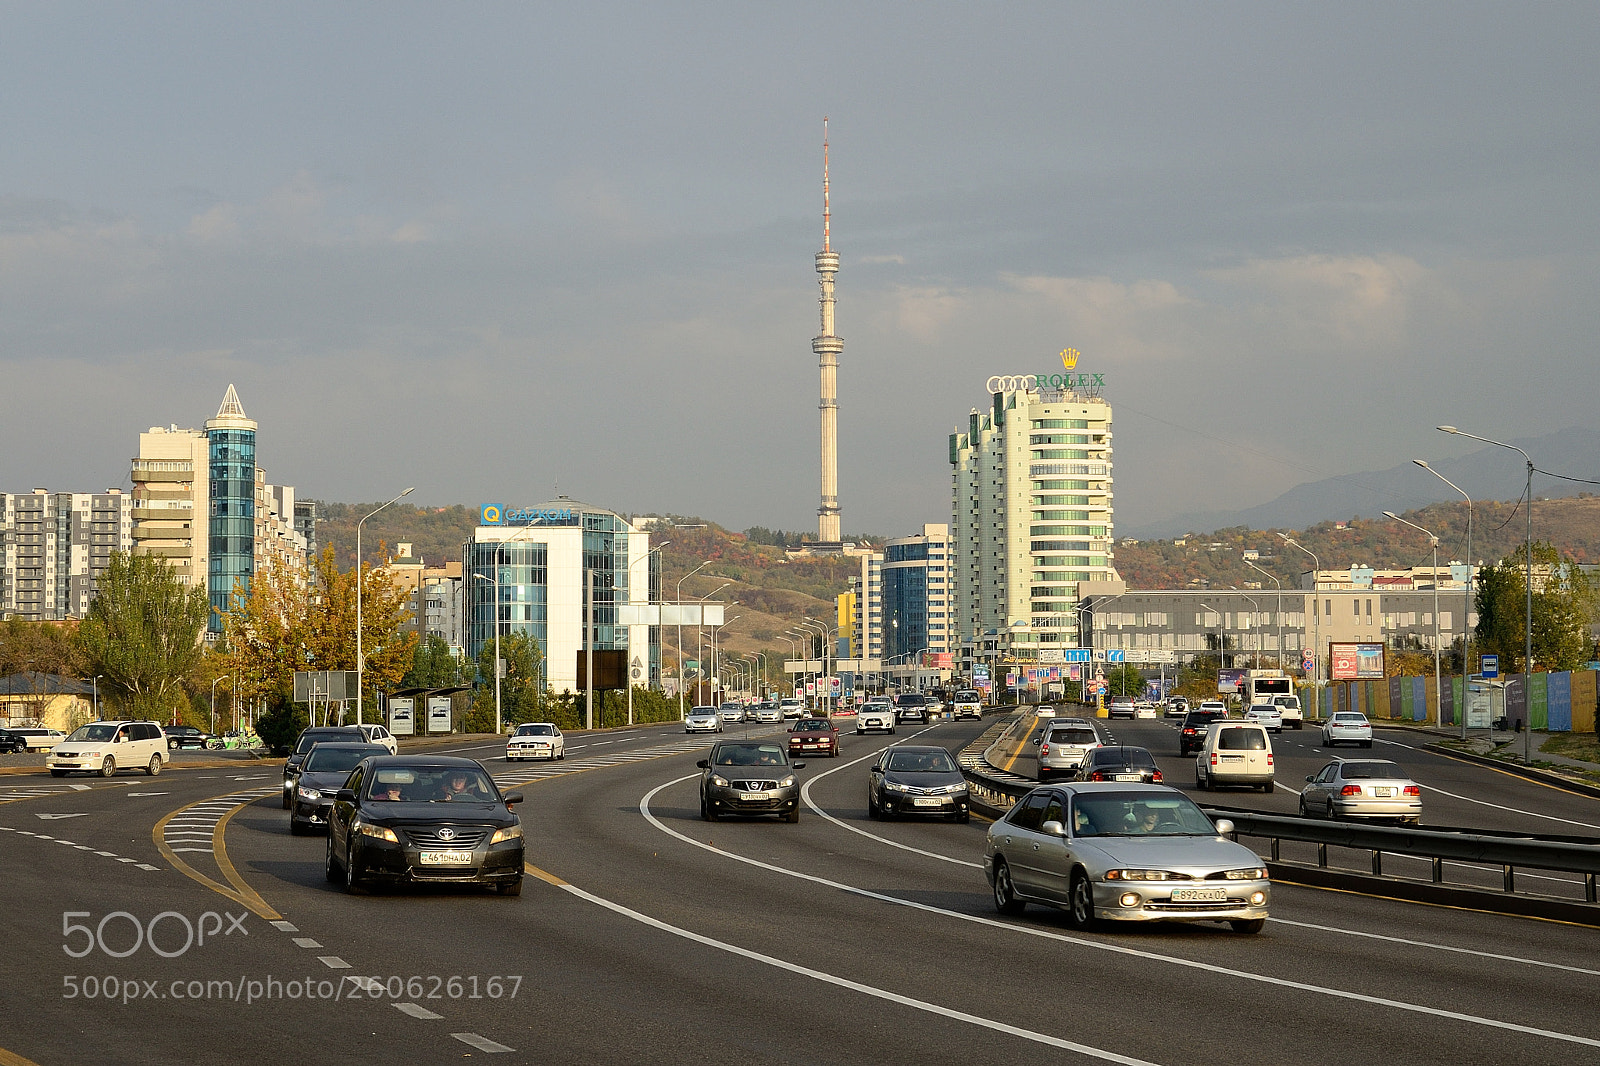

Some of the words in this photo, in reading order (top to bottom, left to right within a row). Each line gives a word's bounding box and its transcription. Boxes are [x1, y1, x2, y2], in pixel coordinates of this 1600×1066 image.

[1036, 373, 1106, 388] ROLEX
[483, 506, 499, 522] Q
[505, 508, 571, 521] QAZKOM
